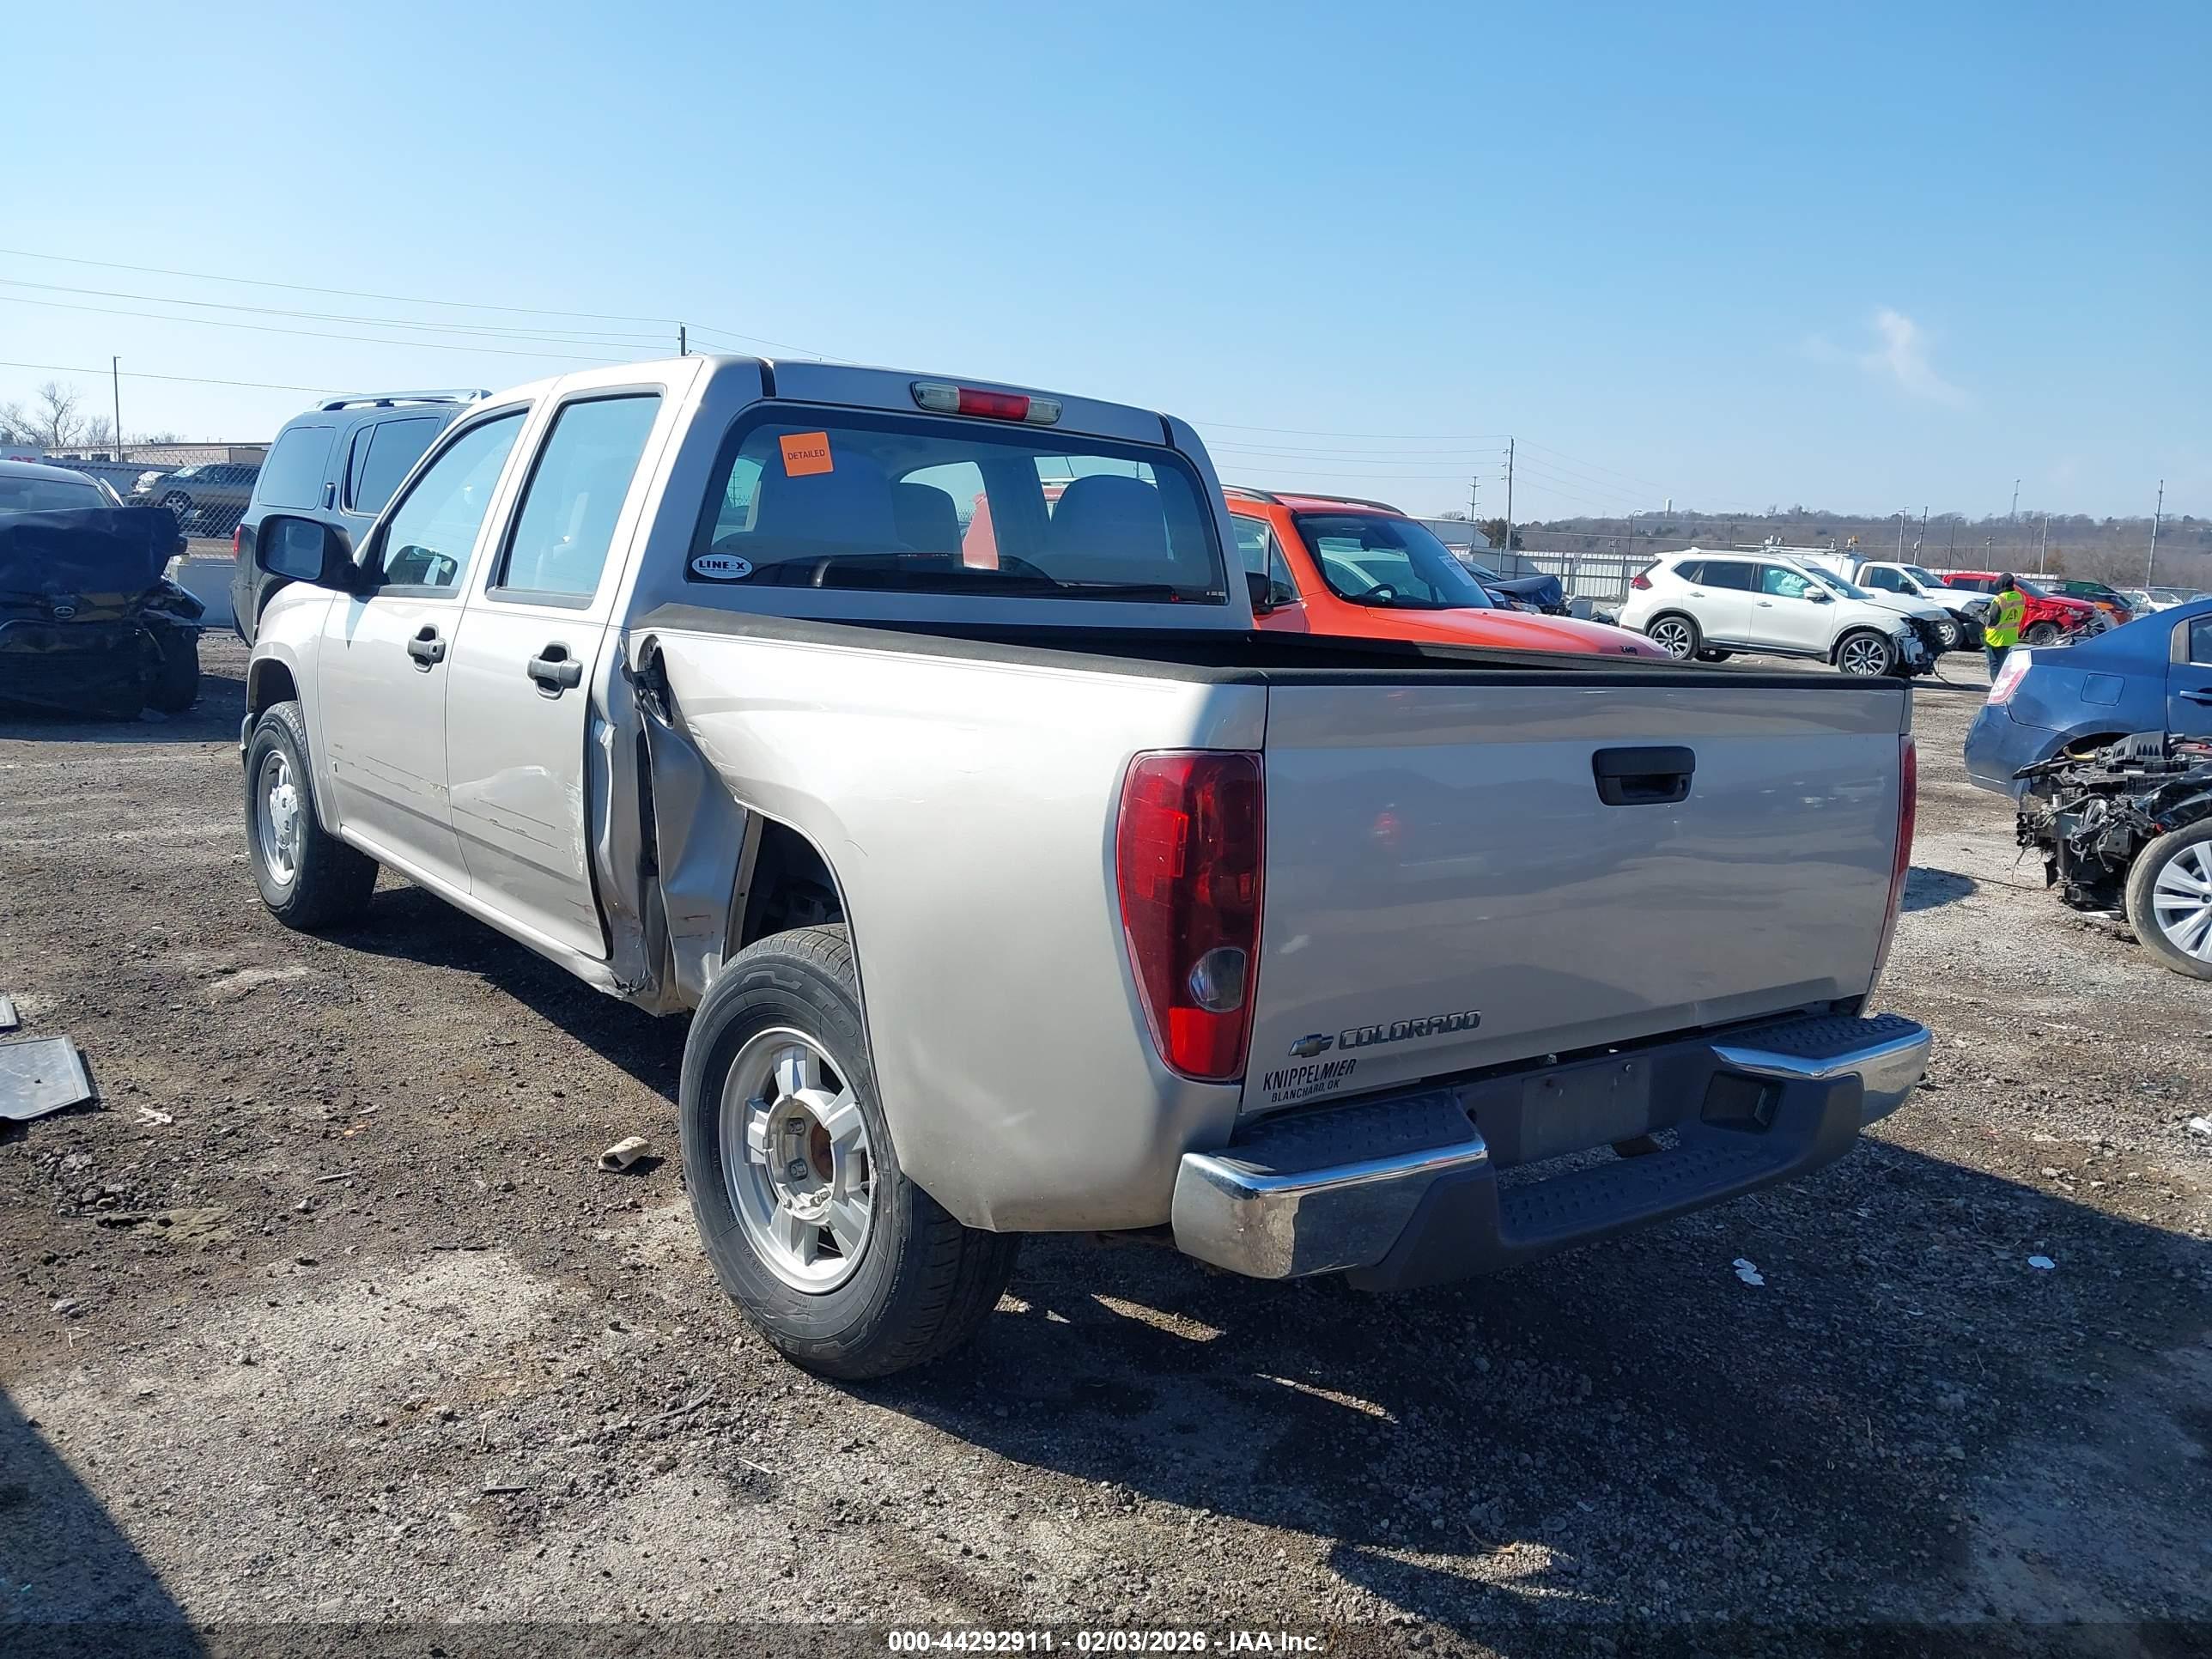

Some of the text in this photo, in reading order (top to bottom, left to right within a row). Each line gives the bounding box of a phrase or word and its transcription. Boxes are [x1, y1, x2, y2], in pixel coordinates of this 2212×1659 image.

[787, 448, 825, 460] DETAILED
[698, 560, 745, 569] LINE-X
[1339, 1009, 1482, 1050] COLORADO
[1263, 1058, 1357, 1091] KNIPPELMIER
[1327, 1079, 1340, 1090] OK
